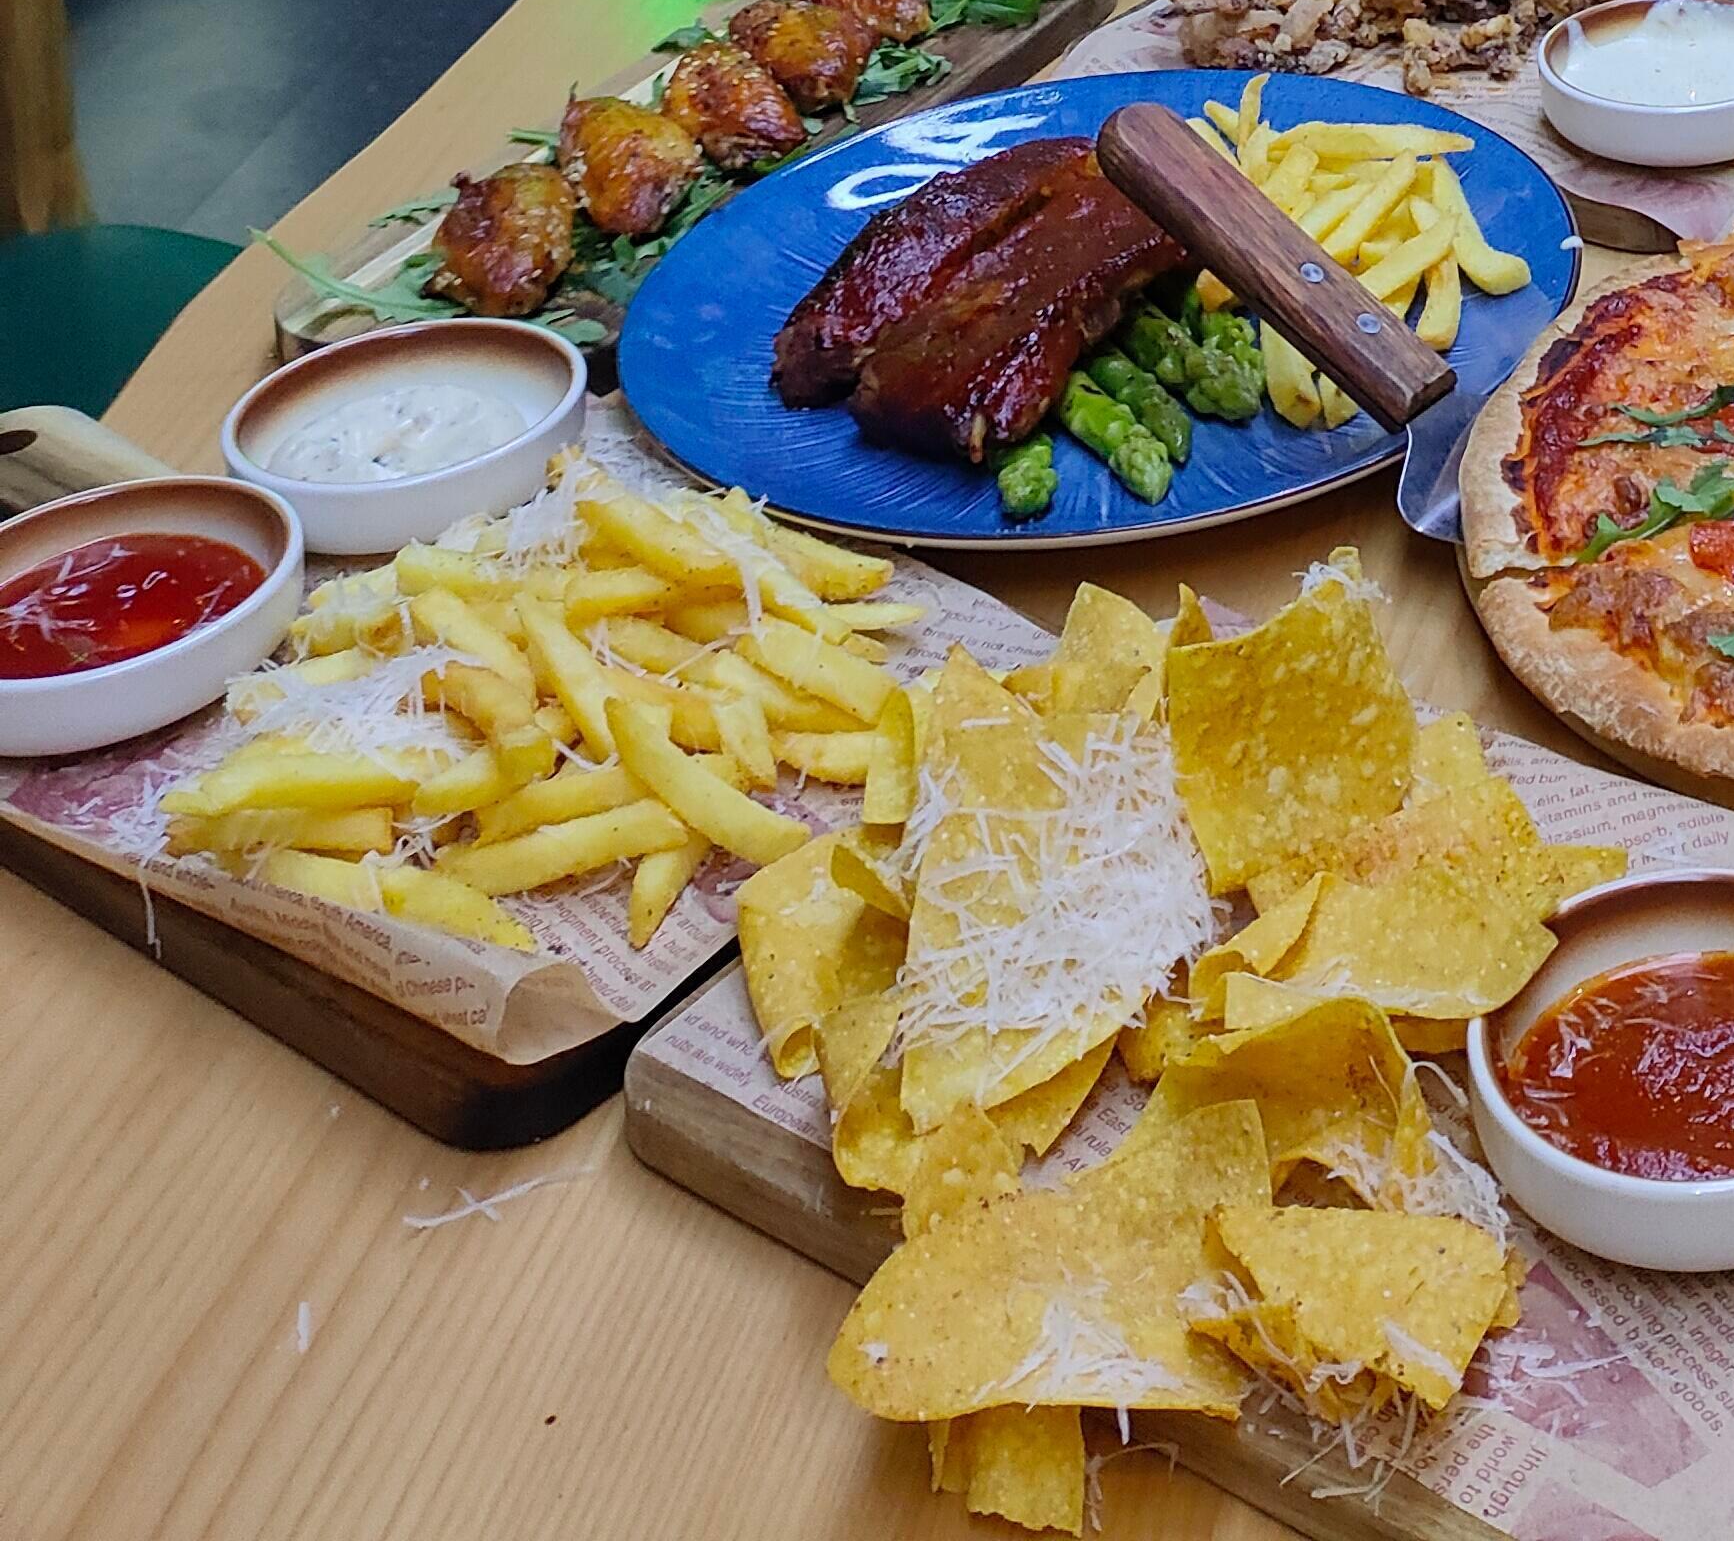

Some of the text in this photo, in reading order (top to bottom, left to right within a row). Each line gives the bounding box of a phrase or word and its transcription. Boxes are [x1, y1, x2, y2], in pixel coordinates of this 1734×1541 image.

[1677, 811, 1727, 832] edible
[1691, 828, 1732, 852] daily
[1097, 1107, 1134, 1137] East
[1458, 1434, 1519, 1506] world to
